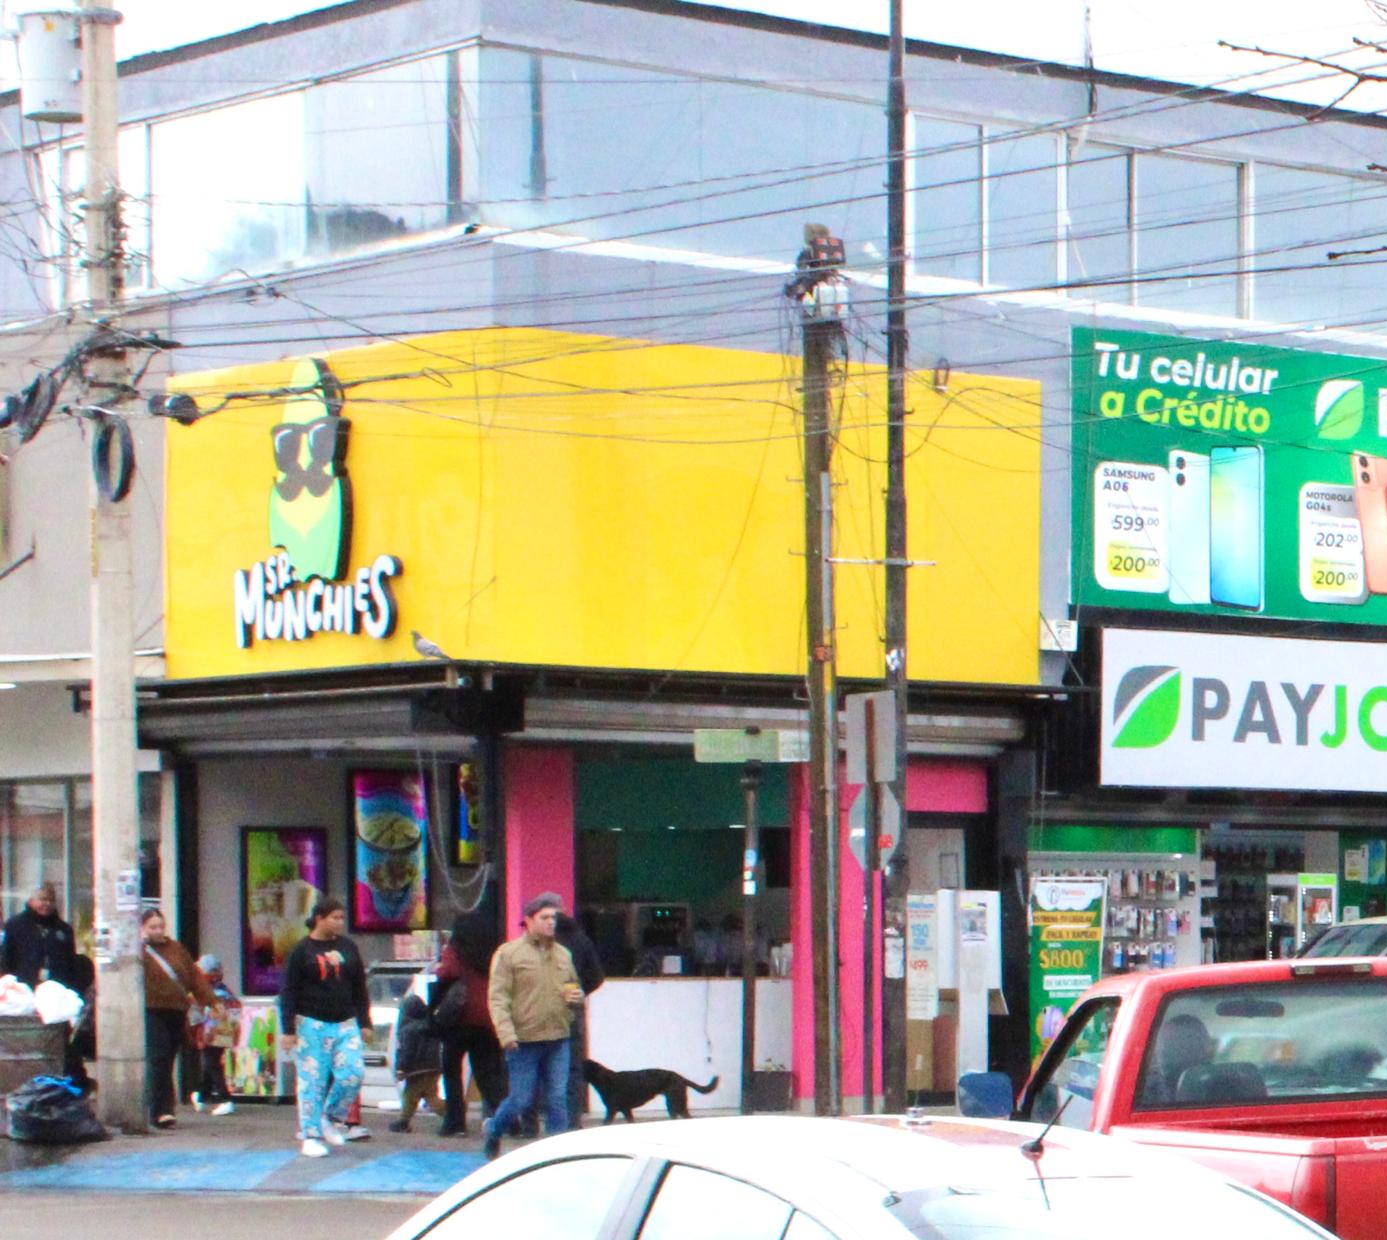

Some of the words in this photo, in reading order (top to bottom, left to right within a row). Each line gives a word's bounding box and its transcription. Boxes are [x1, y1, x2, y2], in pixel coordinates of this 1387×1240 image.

[1095, 342, 1140, 379] Tu
[1150, 353, 1278, 394] celular
[1101, 391, 1125, 418] a
[1136, 388, 1270, 433] Crédito
[1103, 468, 1155, 481] SAMSUNG
[1103, 481, 1129, 492] A06
[1306, 492, 1353, 502] MOTOROLA
[234, 554, 404, 649] MUNCHIES
[1039, 949, 1085, 969] $800
